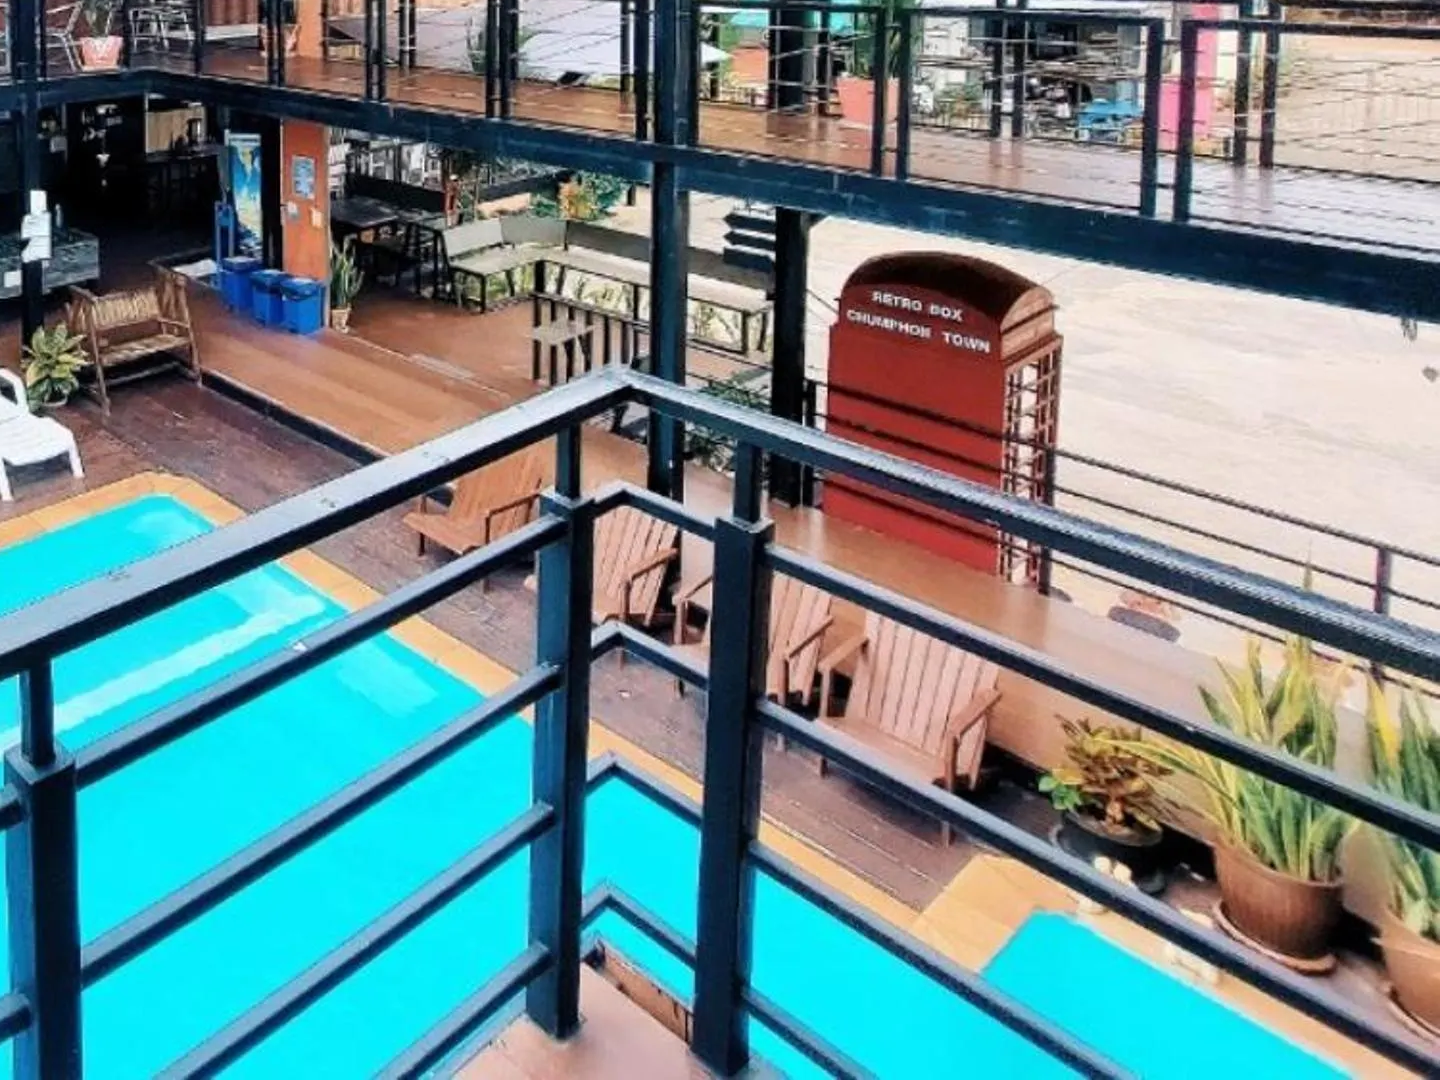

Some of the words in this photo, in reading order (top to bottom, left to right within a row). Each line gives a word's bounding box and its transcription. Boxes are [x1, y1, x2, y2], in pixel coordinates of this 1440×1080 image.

[871, 290, 923, 311] RETRO
[930, 303, 964, 322] BOX
[846, 309, 932, 339] CHUMPHON
[941, 331, 991, 354] TOWN
